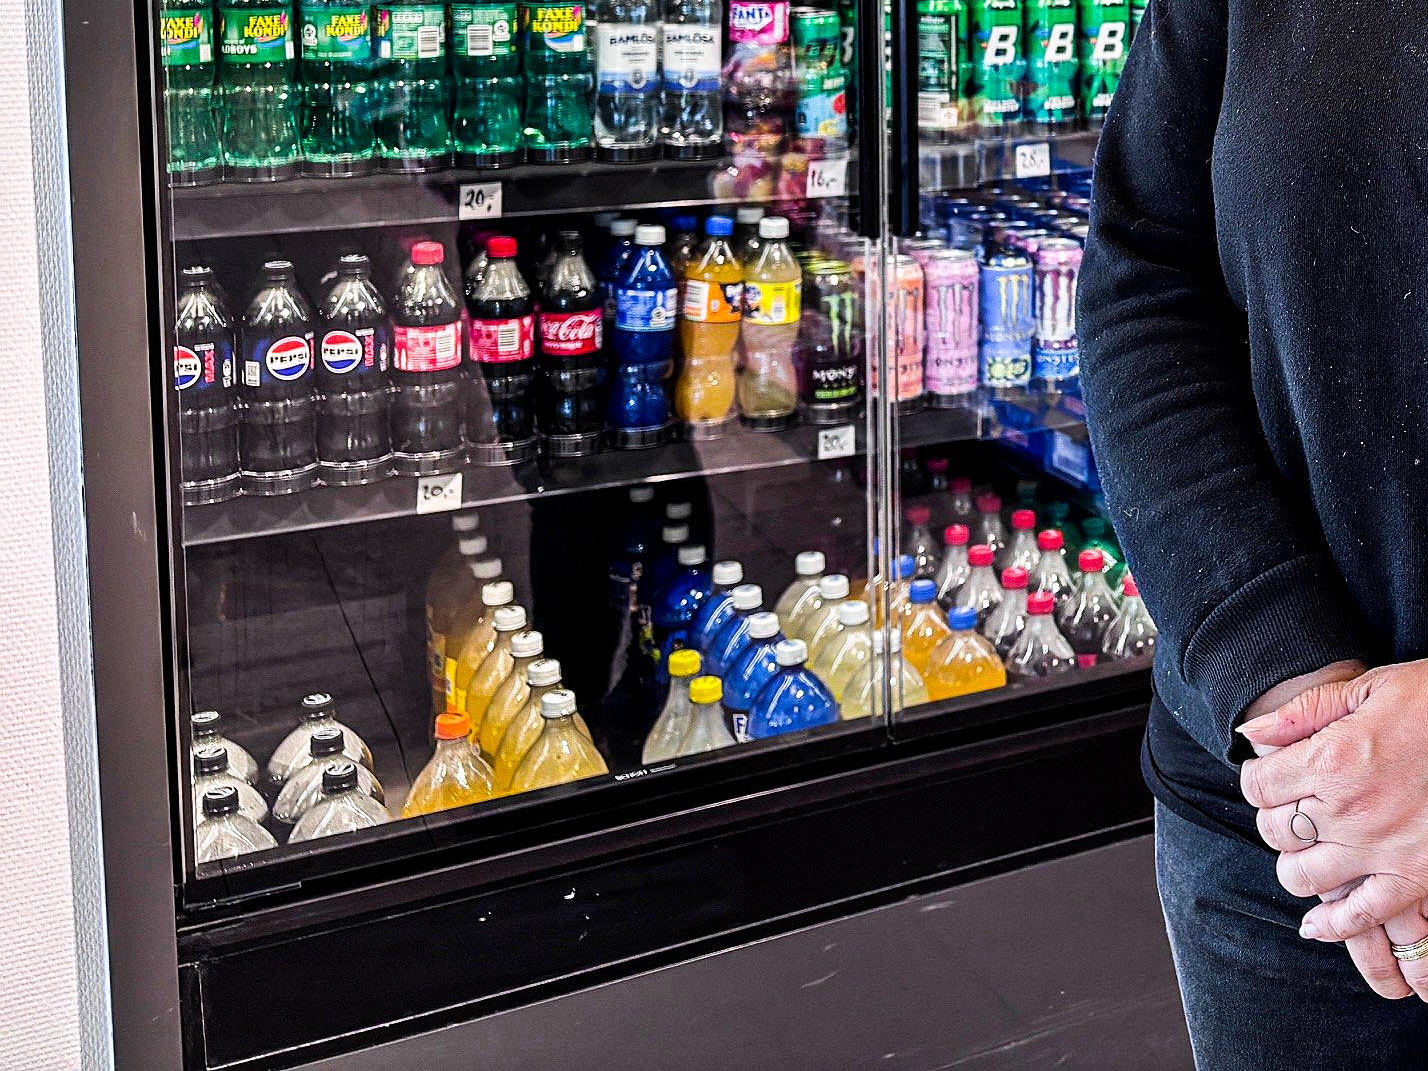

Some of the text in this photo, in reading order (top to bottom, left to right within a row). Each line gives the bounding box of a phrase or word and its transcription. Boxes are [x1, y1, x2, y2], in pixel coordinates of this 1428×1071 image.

[331, 14, 362, 27] FAXE
[536, 7, 574, 20] FAXE
[248, 14, 281, 28] FAXE
[532, 19, 578, 33] KONDI
[244, 25, 286, 38] KONDI
[326, 24, 365, 37] KONDI
[984, 25, 1018, 66] B
[1044, 23, 1075, 63] B
[1093, 21, 1126, 60] B
[465, 188, 496, 213] 20,-
